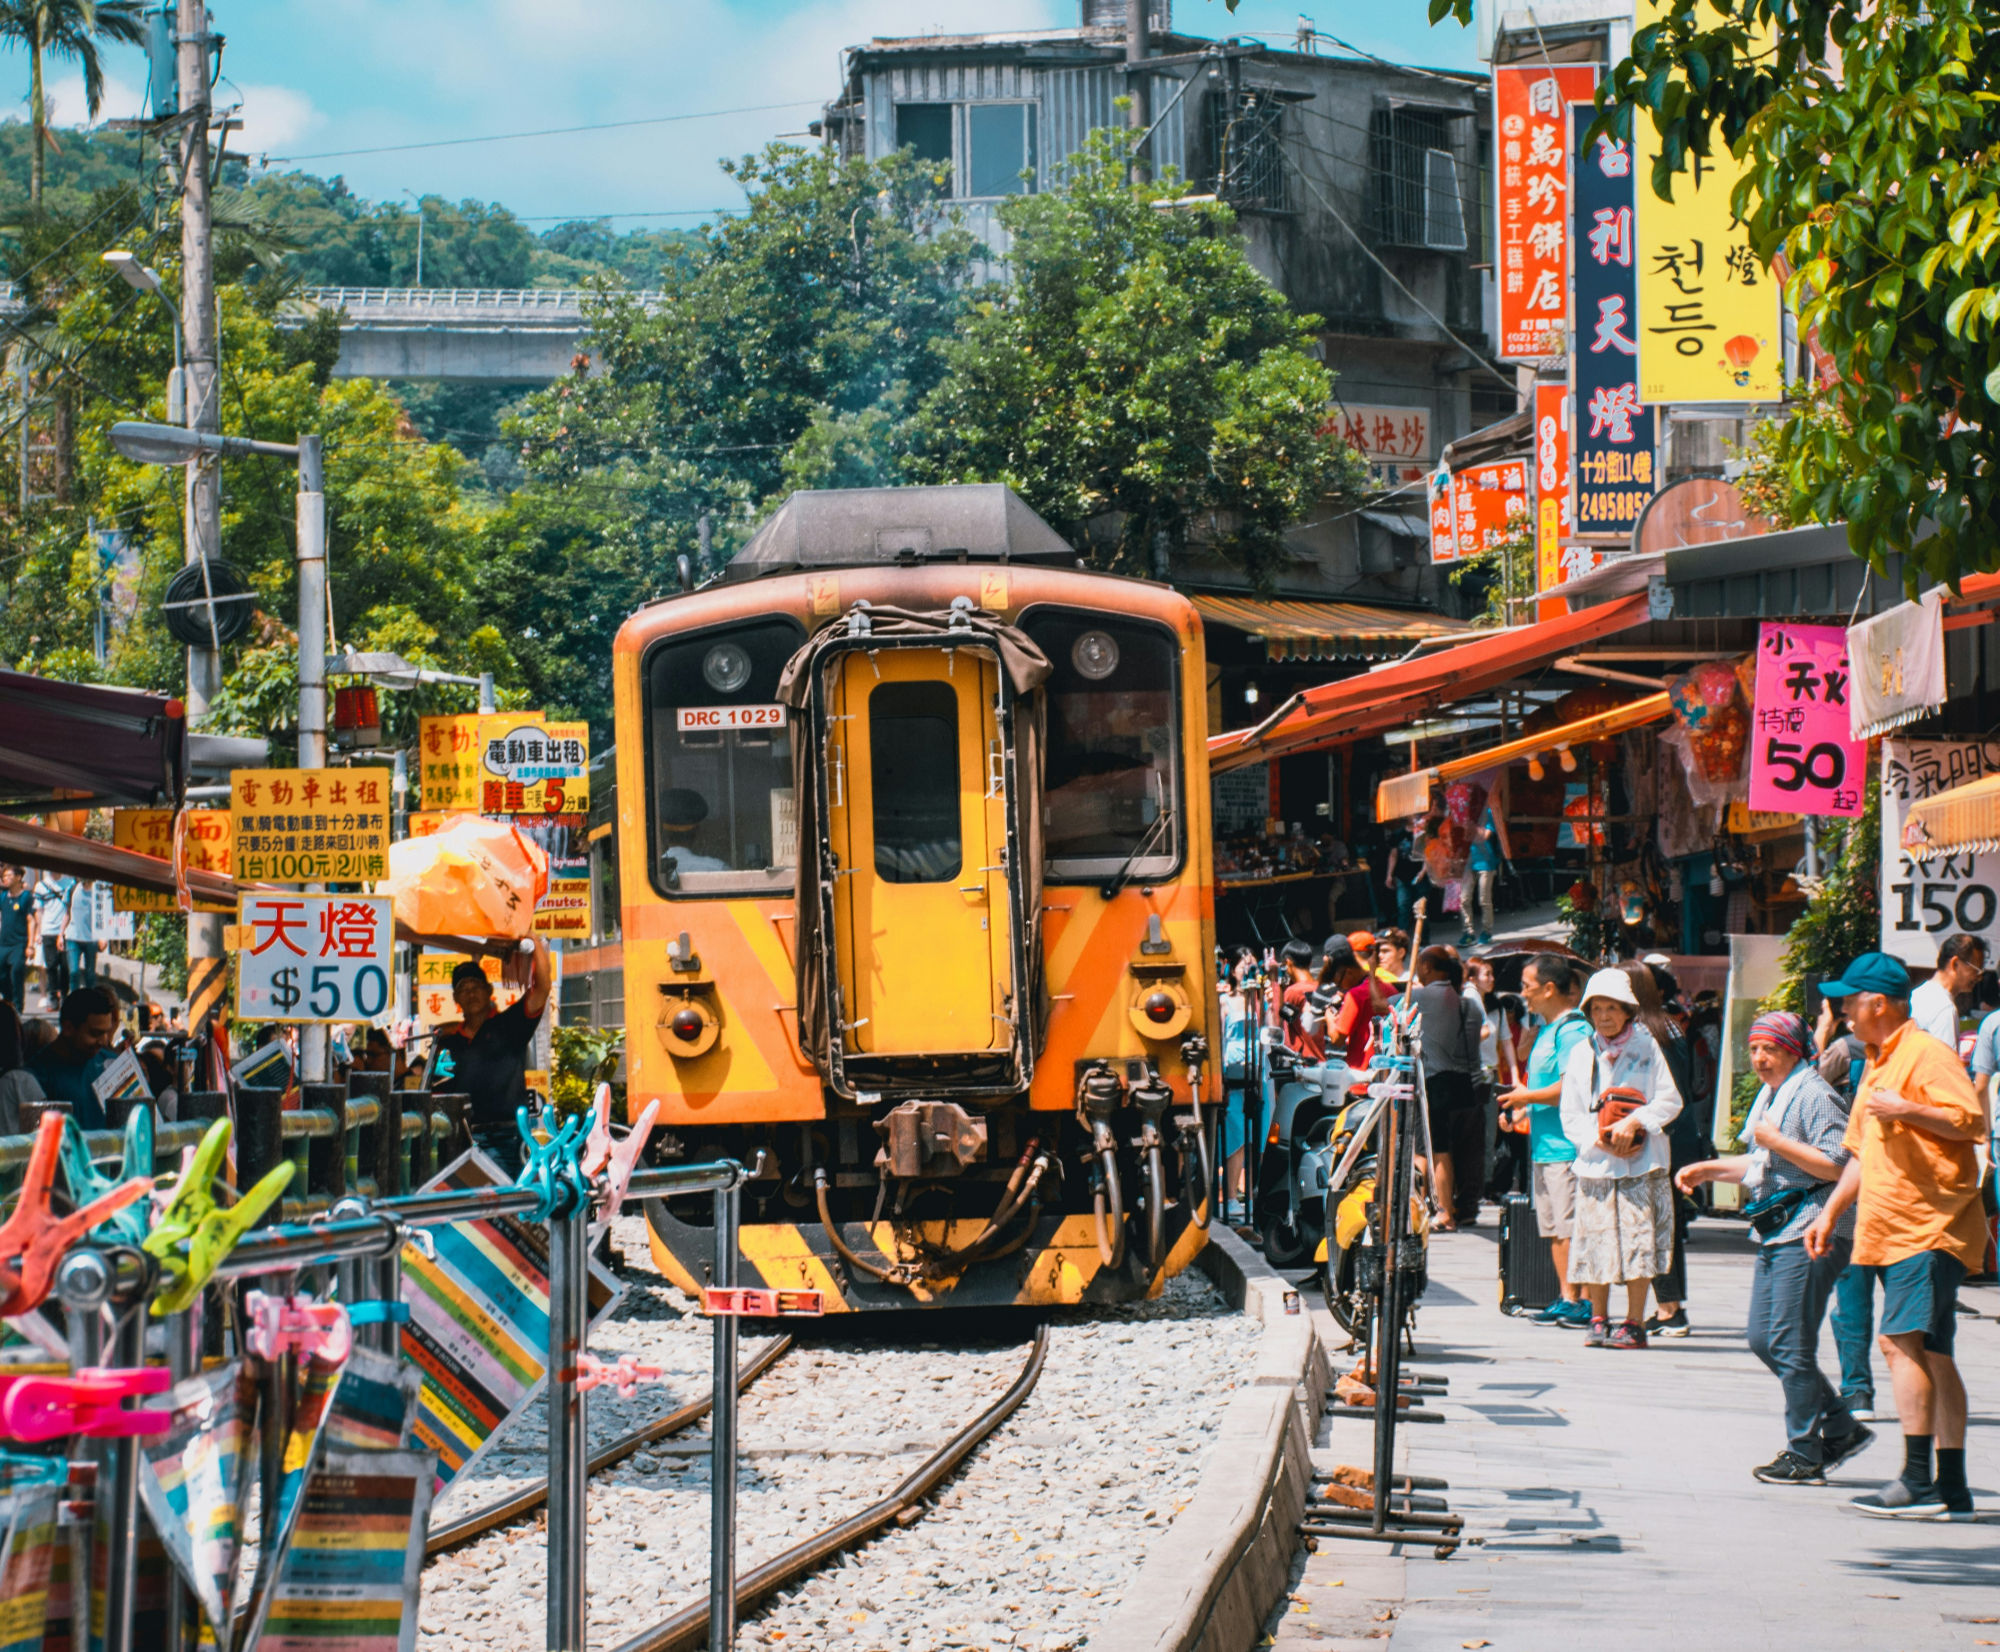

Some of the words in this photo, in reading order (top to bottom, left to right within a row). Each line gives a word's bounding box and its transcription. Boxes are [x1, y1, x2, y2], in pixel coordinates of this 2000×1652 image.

[1525, 77, 1566, 311] 周萬珍餅店
[1647, 238, 1717, 356] 천등
[1579, 451, 1653, 485] 十分街114號
[1765, 631, 1795, 656] 小
[684, 711, 721, 726] DRC
[728, 708, 781, 725] 1029
[488, 739, 581, 764] 電動車出租
[1766, 737, 1847, 792] 50
[238, 776, 381, 809] 電動車出租
[1832, 790, 1859, 811] 起
[535, 916, 551, 930] and
[1891, 883, 1998, 932] 150
[250, 901, 379, 958] 天燈
[270, 964, 388, 1018] $50
